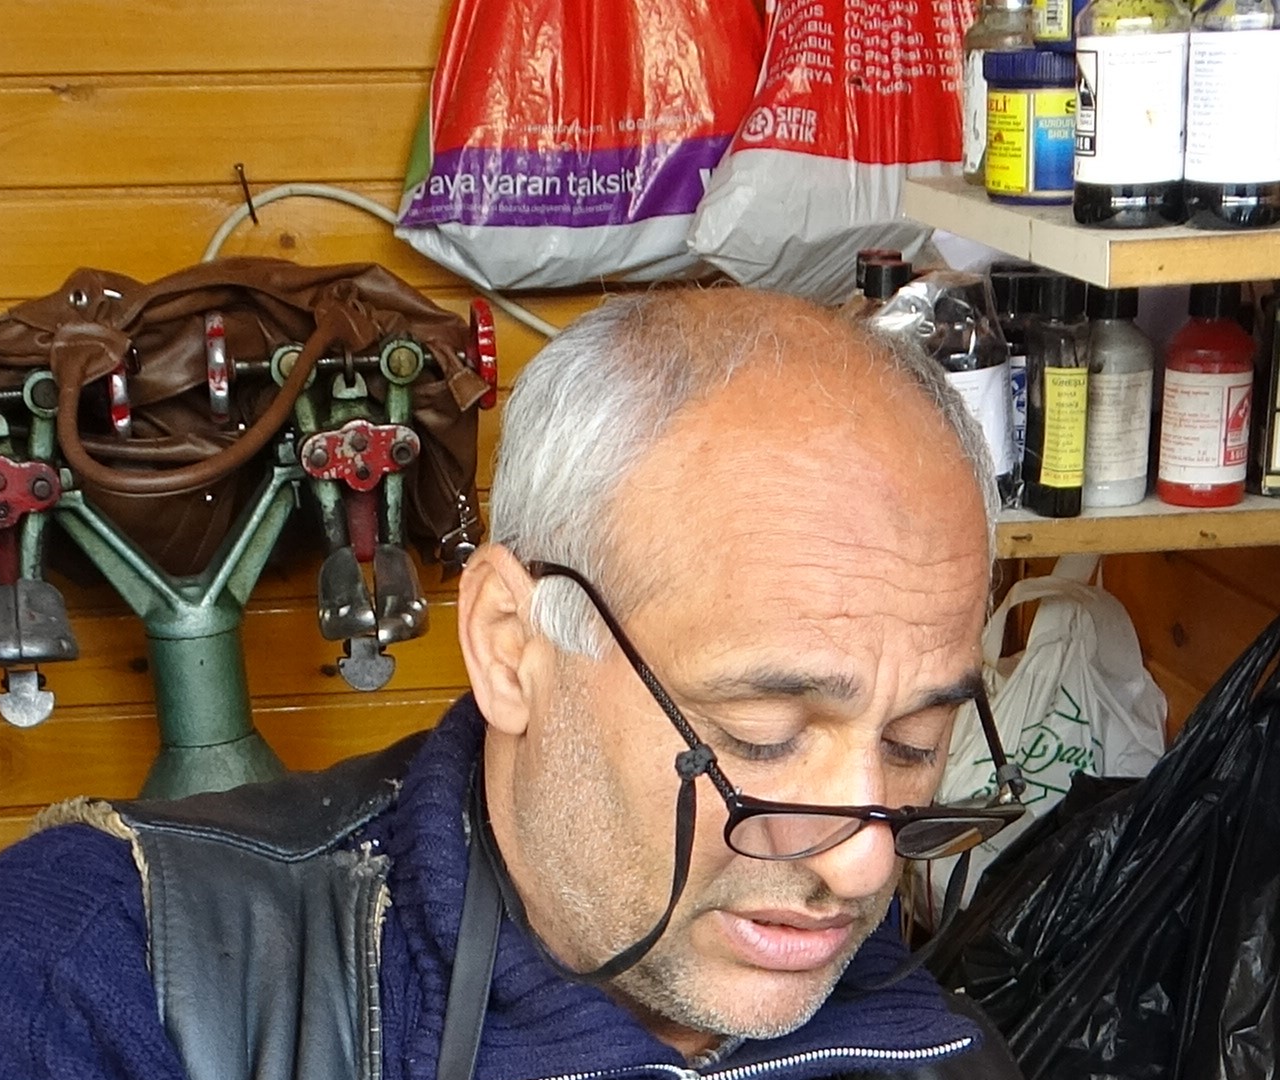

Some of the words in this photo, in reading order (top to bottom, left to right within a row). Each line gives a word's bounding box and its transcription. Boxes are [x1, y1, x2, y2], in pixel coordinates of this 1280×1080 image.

[776, 106, 817, 126] SIFIR
[775, 123, 815, 144] ATIK
[482, 175, 560, 196] varan
[567, 167, 643, 197] taksit!
